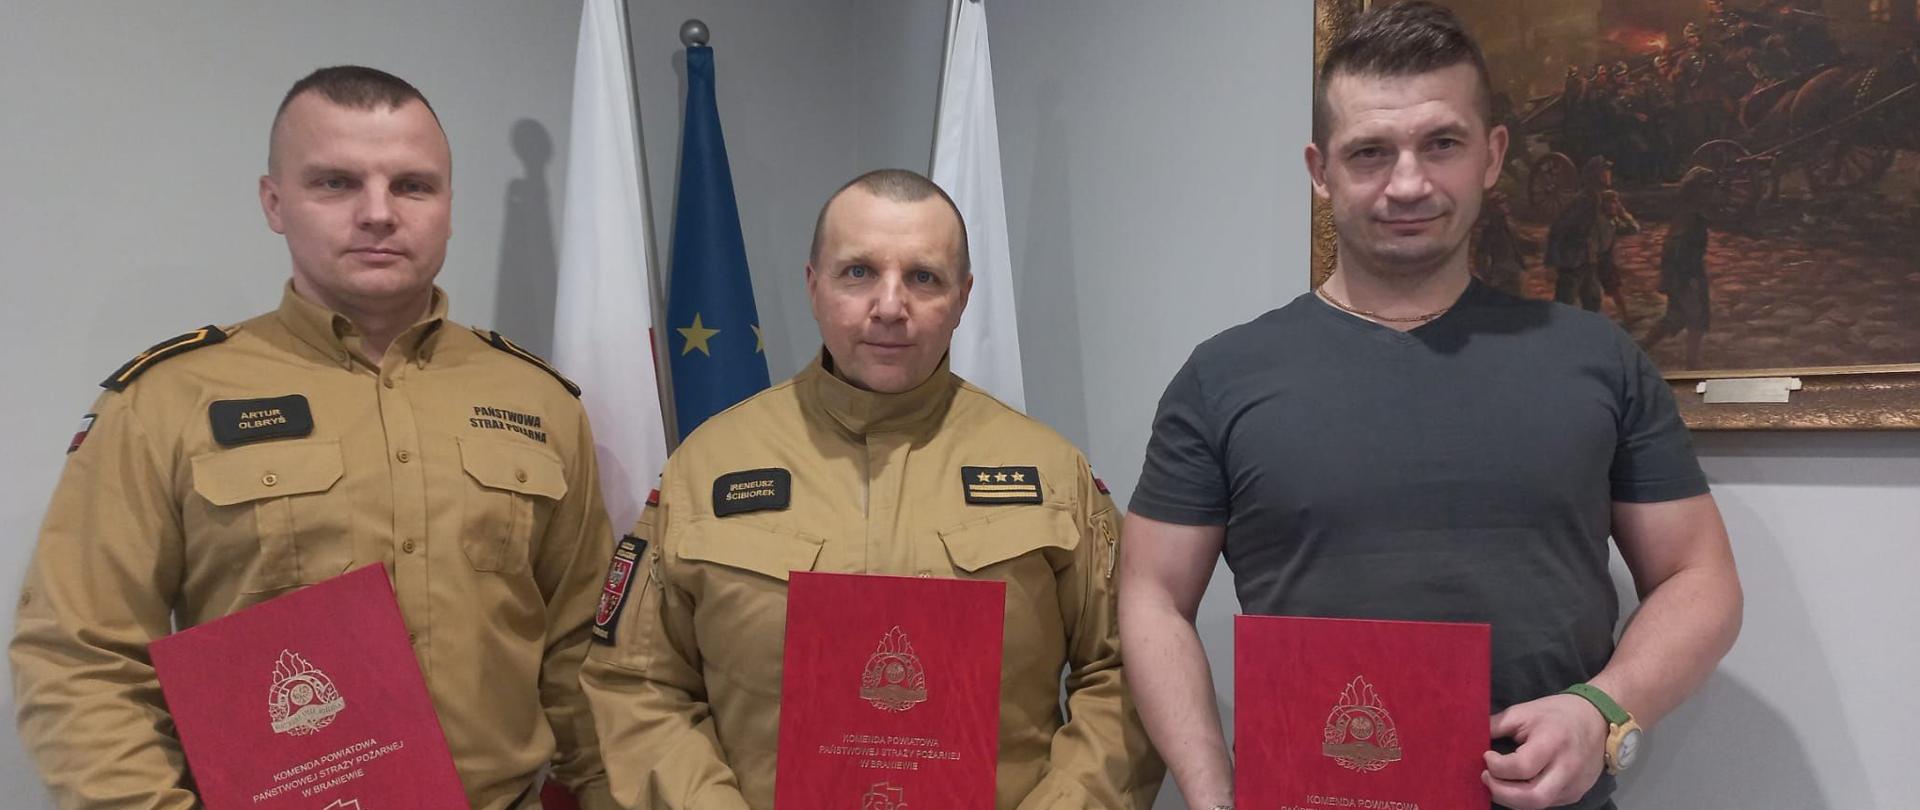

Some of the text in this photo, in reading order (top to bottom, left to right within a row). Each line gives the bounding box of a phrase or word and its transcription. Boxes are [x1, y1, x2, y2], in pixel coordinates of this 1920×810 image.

[240, 409, 281, 420] ARTUR
[473, 406, 542, 429] PAŃSTWOWA
[730, 480, 774, 491] IRENEUSZ
[726, 489, 775, 501] ŚCIBIOREK
[842, 733, 939, 747] KOMENDA POWIATOWA
[819, 744, 879, 756] PAŃSTWOWEJ
[273, 738, 377, 782] KOMENDA POWIATOWA
[871, 760, 918, 771] BRANIEWIE
[252, 773, 318, 803] PAŃSTWOWEJ
[356, 740, 404, 764] POŻARNEJ
[301, 768, 365, 798] W BRANIEWIE
[1306, 794, 1419, 810] KOMENDA POWIATOWA
